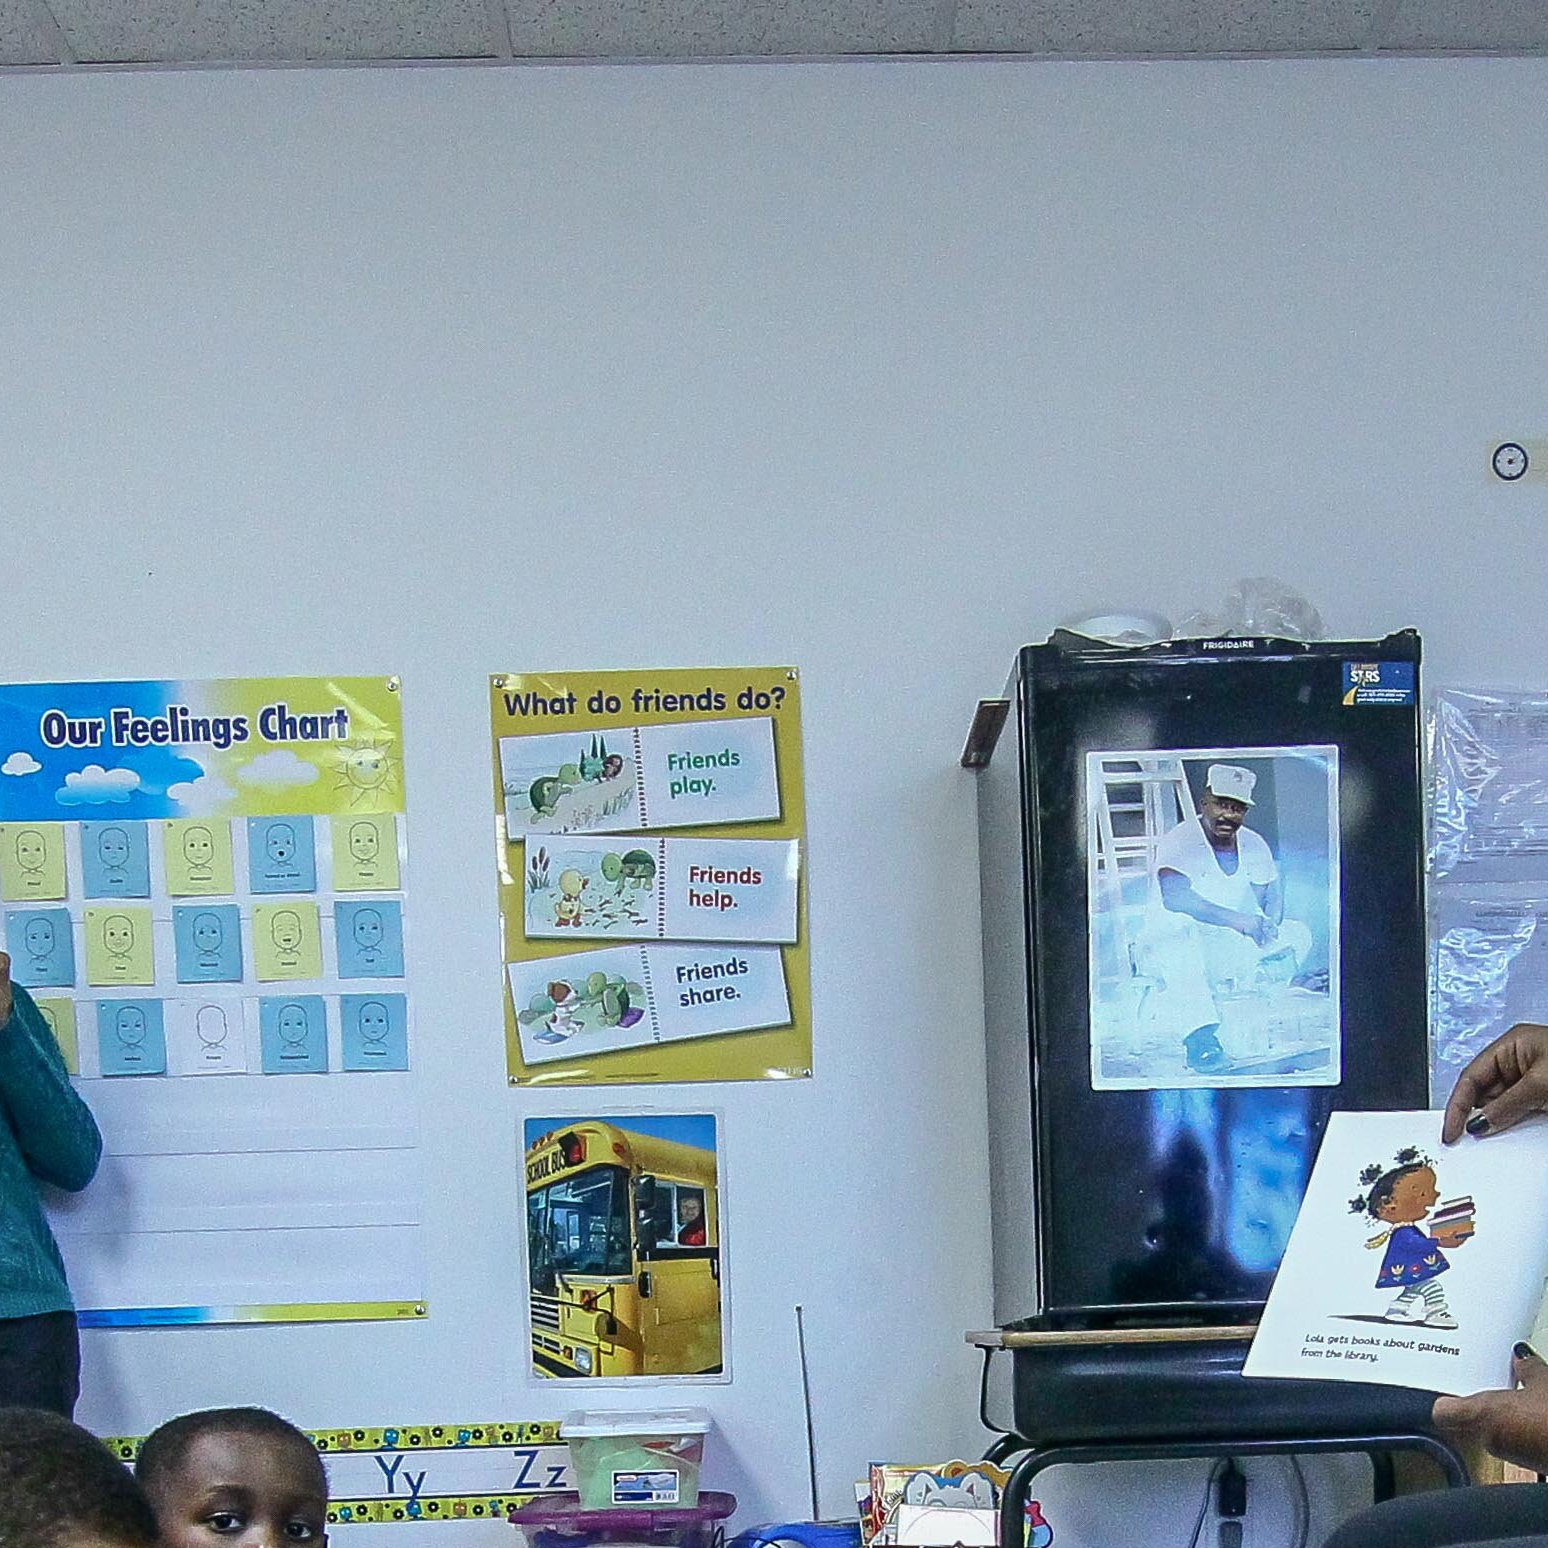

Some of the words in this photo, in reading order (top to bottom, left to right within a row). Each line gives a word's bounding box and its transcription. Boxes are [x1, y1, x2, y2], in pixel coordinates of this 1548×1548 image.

[1202, 639, 1255, 650] FRIGIDAIRE
[504, 691, 577, 717] What
[587, 691, 622, 715] do
[631, 688, 727, 713] friends
[737, 687, 787, 711] do?
[41, 711, 103, 747] Our
[111, 706, 250, 748] Feelings
[258, 704, 349, 742] Chart
[667, 749, 741, 772] Friends
[669, 775, 717, 799] play.
[688, 864, 763, 886] Friends
[688, 889, 739, 911] help.
[675, 957, 750, 985] Friends
[679, 984, 742, 1008] share.
[526, 1155, 552, 1185] SCHOOL
[1301, 1347, 1324, 1358] from
[1325, 1349, 1343, 1359] the
[1344, 1349, 1379, 1363] library.
[1305, 1333, 1324, 1343] Lola
[1327, 1335, 1349, 1345] gets
[1351, 1335, 1381, 1347] books
[1383, 1337, 1415, 1349] about
[1417, 1341, 1461, 1357] gardens
[373, 1454, 428, 1502] Yy
[513, 1449, 569, 1489] Zz
